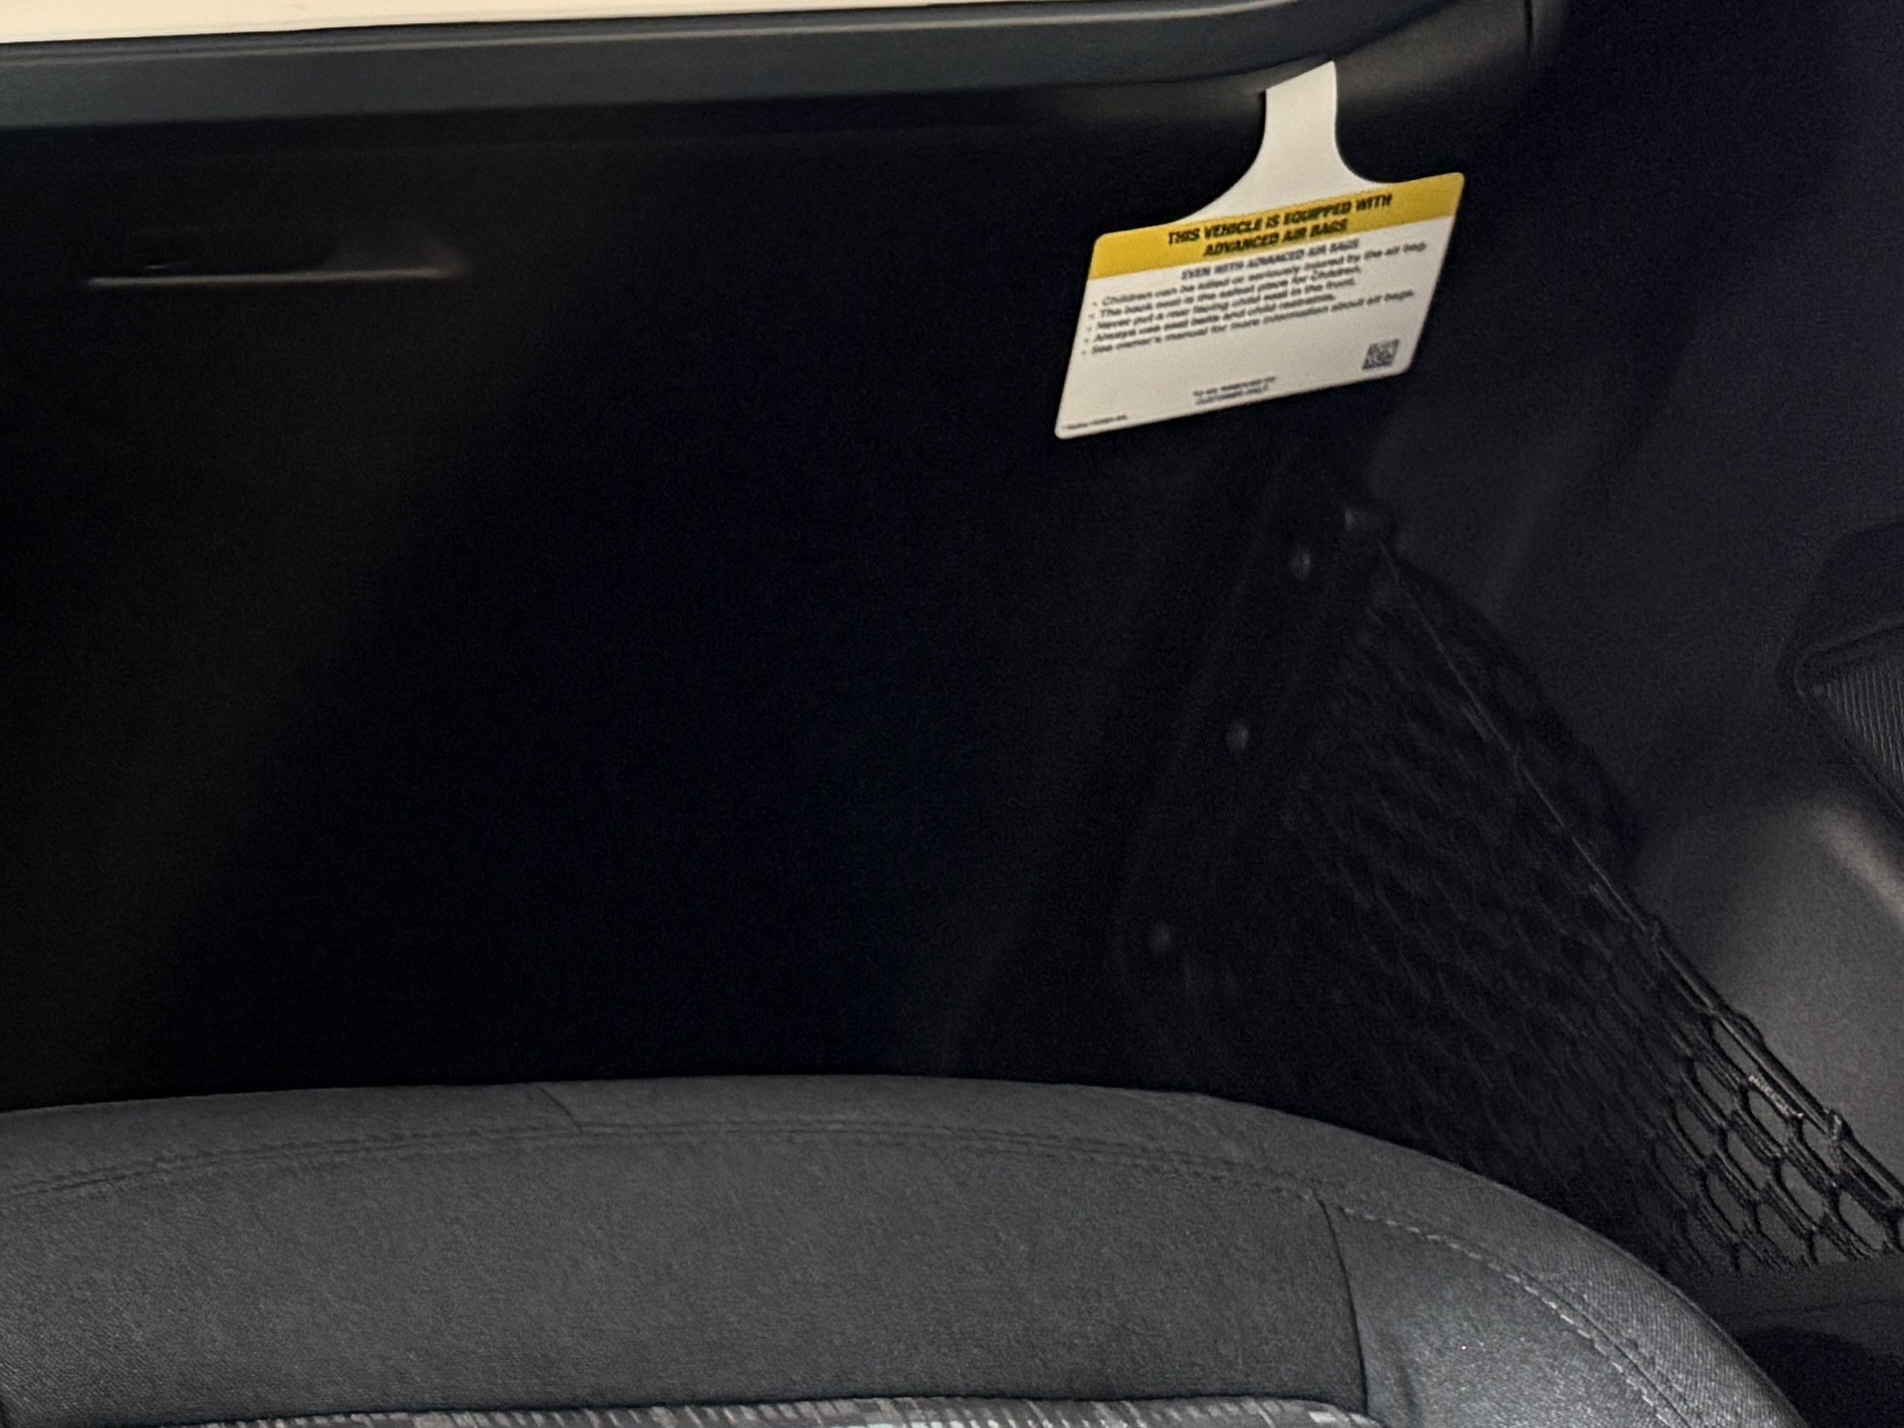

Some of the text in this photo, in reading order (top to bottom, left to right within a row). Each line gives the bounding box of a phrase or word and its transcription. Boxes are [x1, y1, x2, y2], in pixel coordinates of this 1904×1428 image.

[1167, 193, 1393, 244] THIS VEHICLE IS EQUIPPED WITH
[1204, 218, 1348, 255] ADVANCED AIR BAGS
